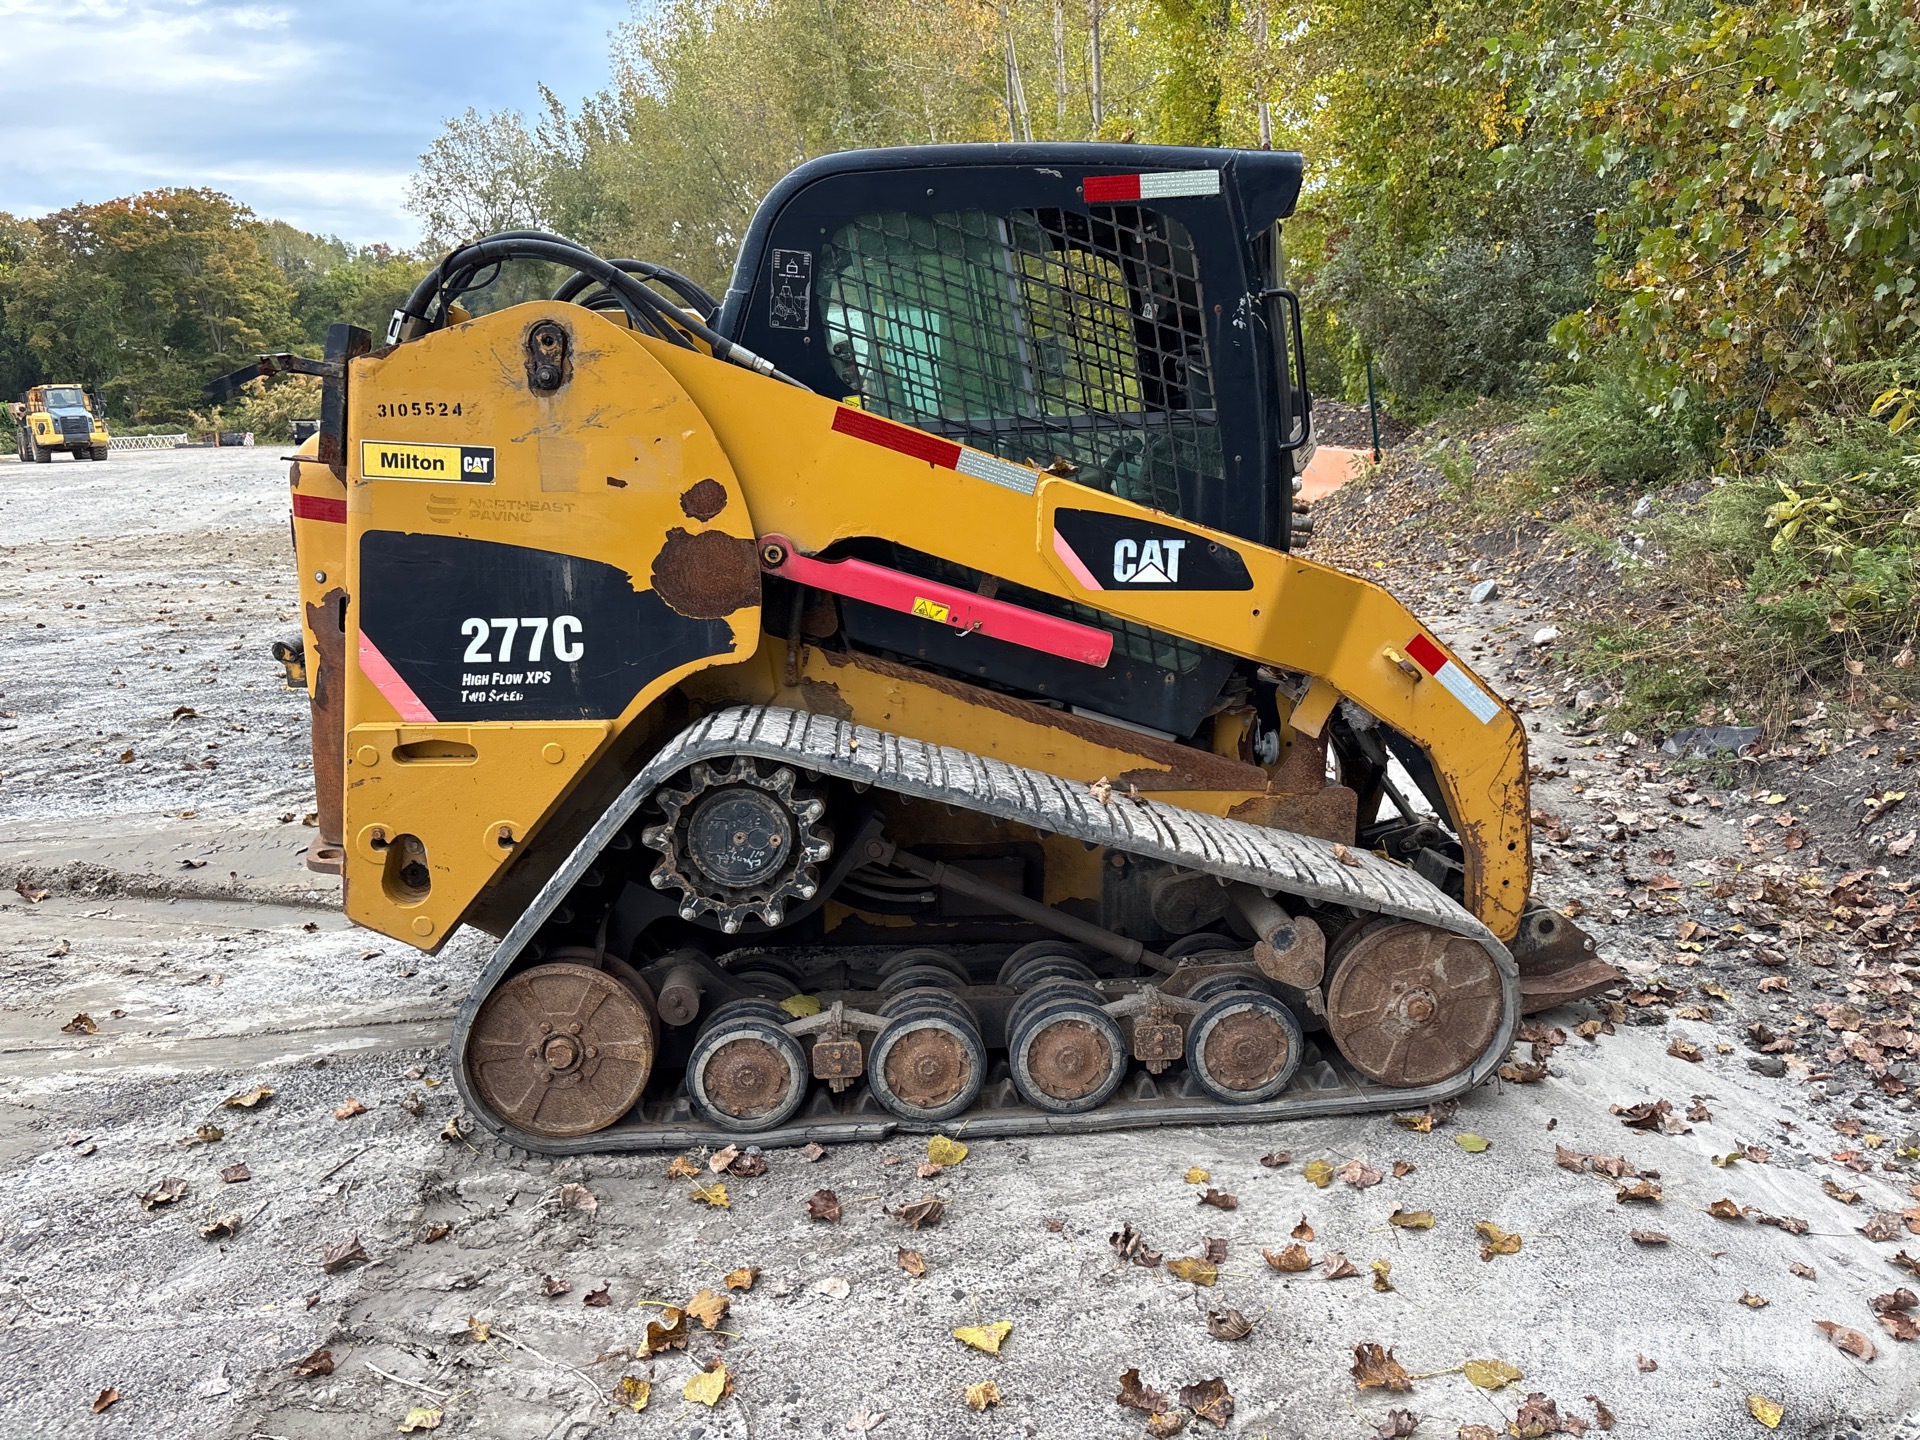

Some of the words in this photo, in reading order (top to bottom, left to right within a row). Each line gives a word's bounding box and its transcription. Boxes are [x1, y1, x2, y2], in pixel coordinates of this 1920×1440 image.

[377, 402, 463, 418] 3105524
[380, 452, 445, 471] Milton
[463, 456, 491, 473] CAT
[469, 498, 576, 513] NORTHEAST
[469, 510, 533, 523] PAVING
[1113, 538, 1186, 583] CAT
[461, 615, 585, 663] 277C
[525, 671, 552, 684] XPS
